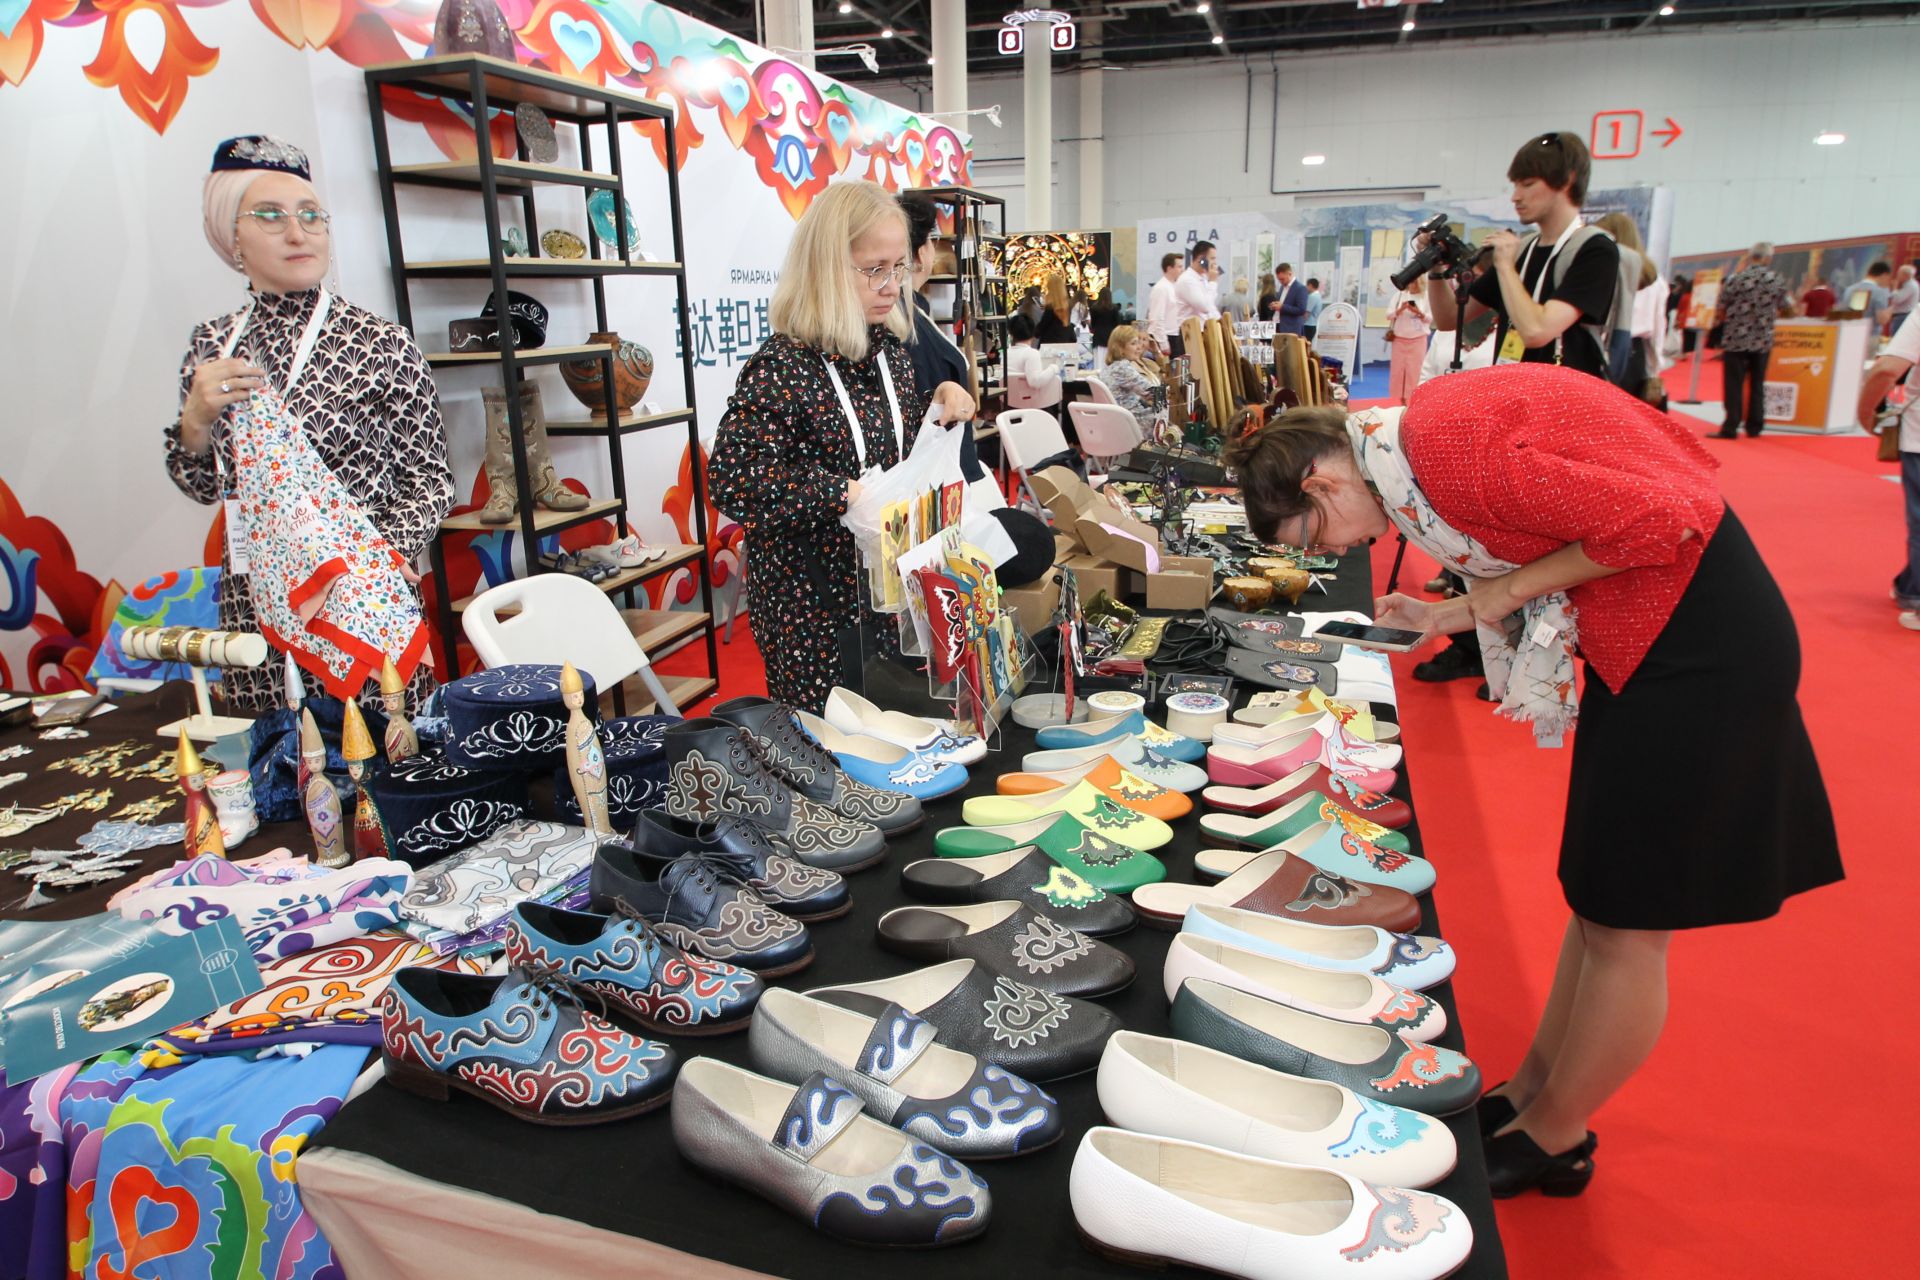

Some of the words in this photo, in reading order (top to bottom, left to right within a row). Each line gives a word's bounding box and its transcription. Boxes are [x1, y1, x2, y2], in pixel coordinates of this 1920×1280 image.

[1005, 33, 1016, 49] 8
[1057, 29, 1069, 45] 8
[1609, 120, 1621, 150] 1
[1147, 228, 1219, 244] ВОДА
[730, 268, 772, 285] ЯРМАРКА
